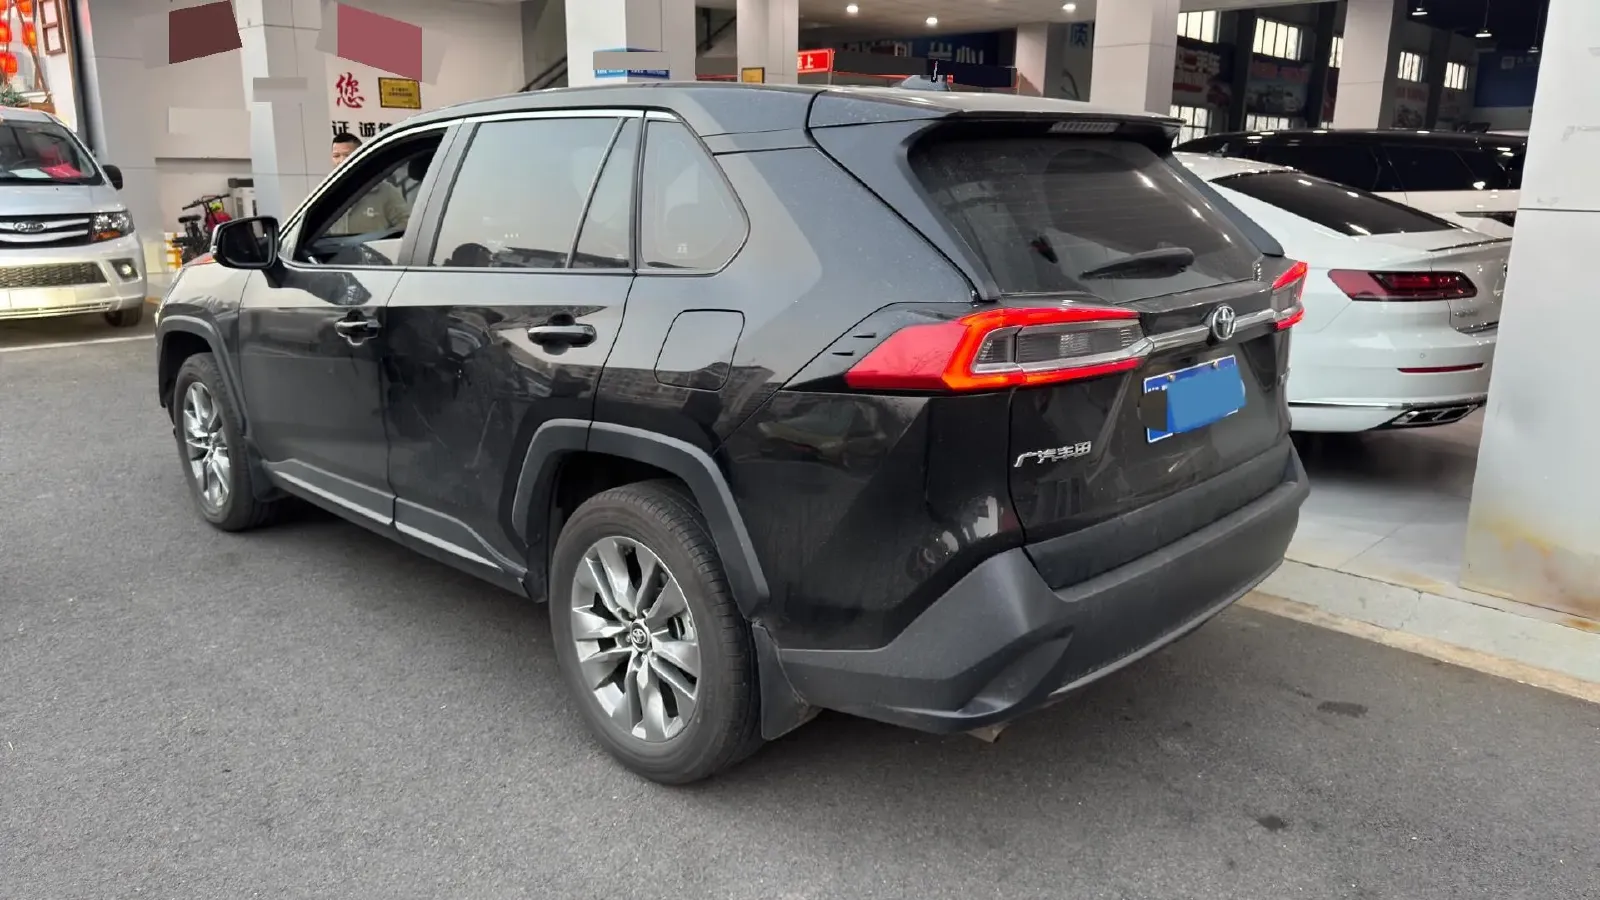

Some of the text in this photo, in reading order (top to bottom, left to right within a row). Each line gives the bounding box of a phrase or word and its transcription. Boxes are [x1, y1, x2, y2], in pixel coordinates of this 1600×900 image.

[336, 72, 364, 108] 您
[1013, 440, 1092, 468] 广汽丰田
